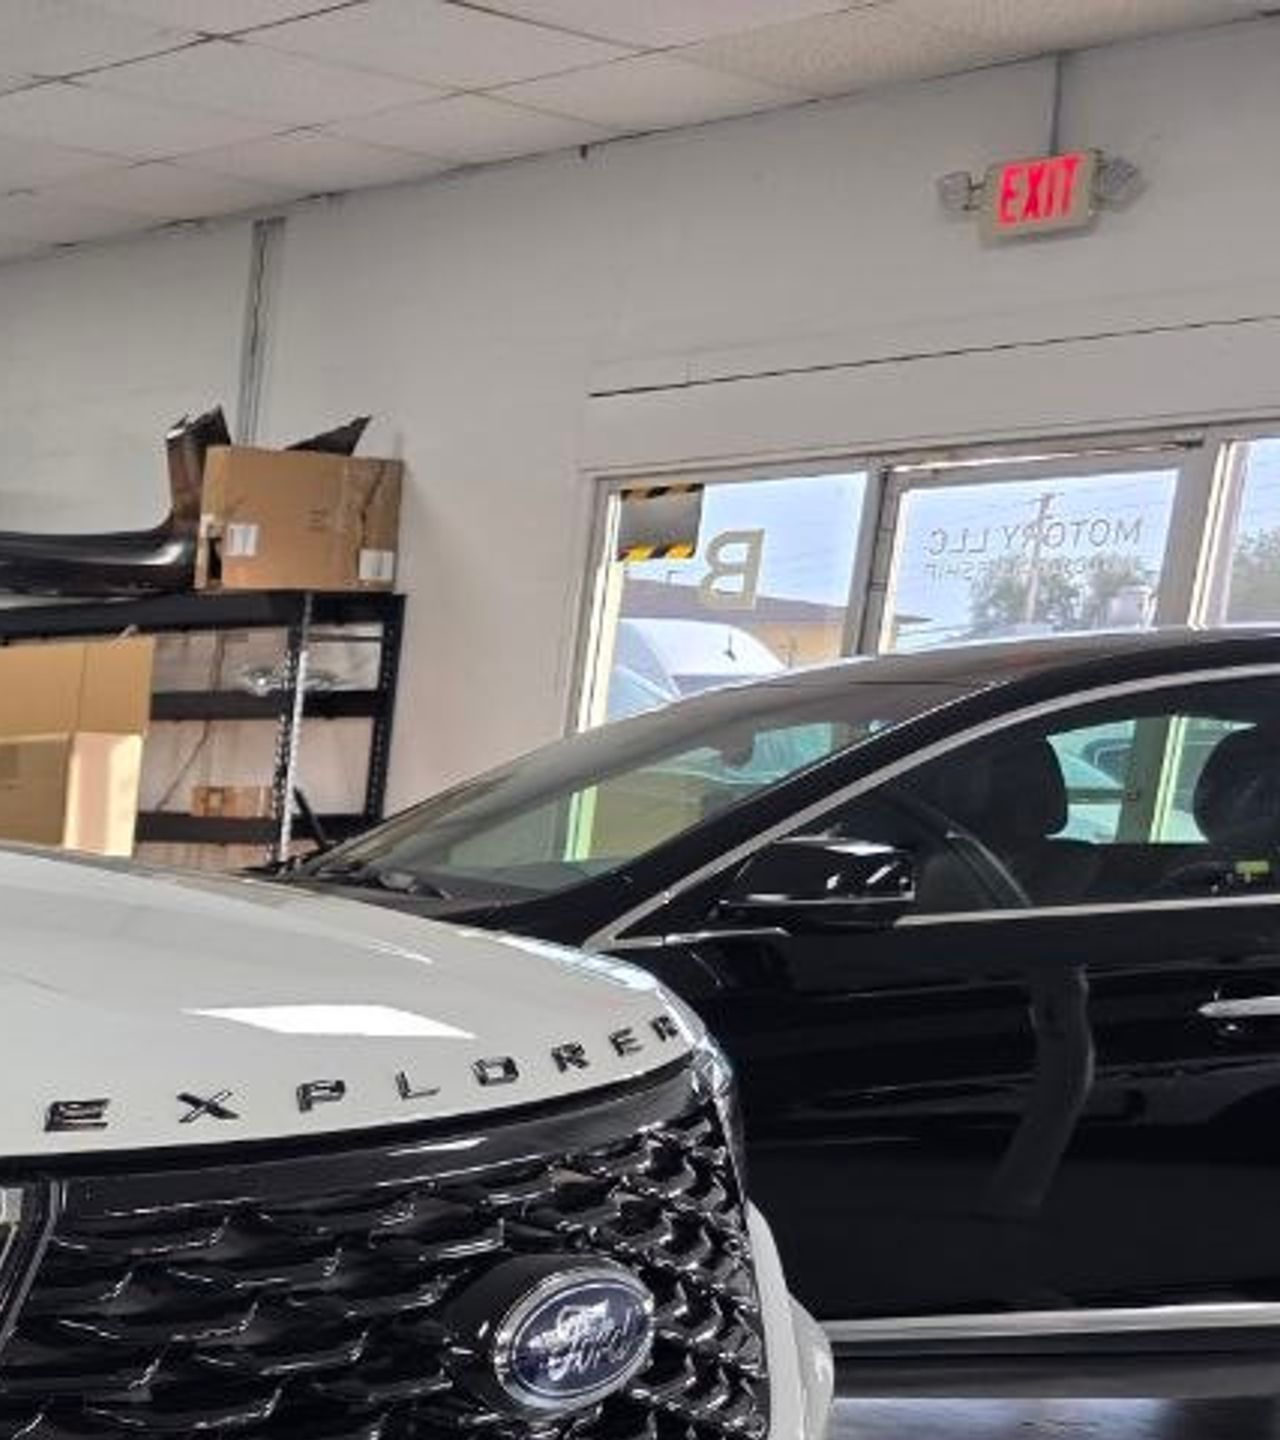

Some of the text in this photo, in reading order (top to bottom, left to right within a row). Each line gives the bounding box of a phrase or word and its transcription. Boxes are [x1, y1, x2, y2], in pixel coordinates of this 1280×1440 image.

[999, 153, 1079, 224] EXIT
[44, 1015, 679, 1133] EXPLORER
[542, 1300, 636, 1382] Ford
